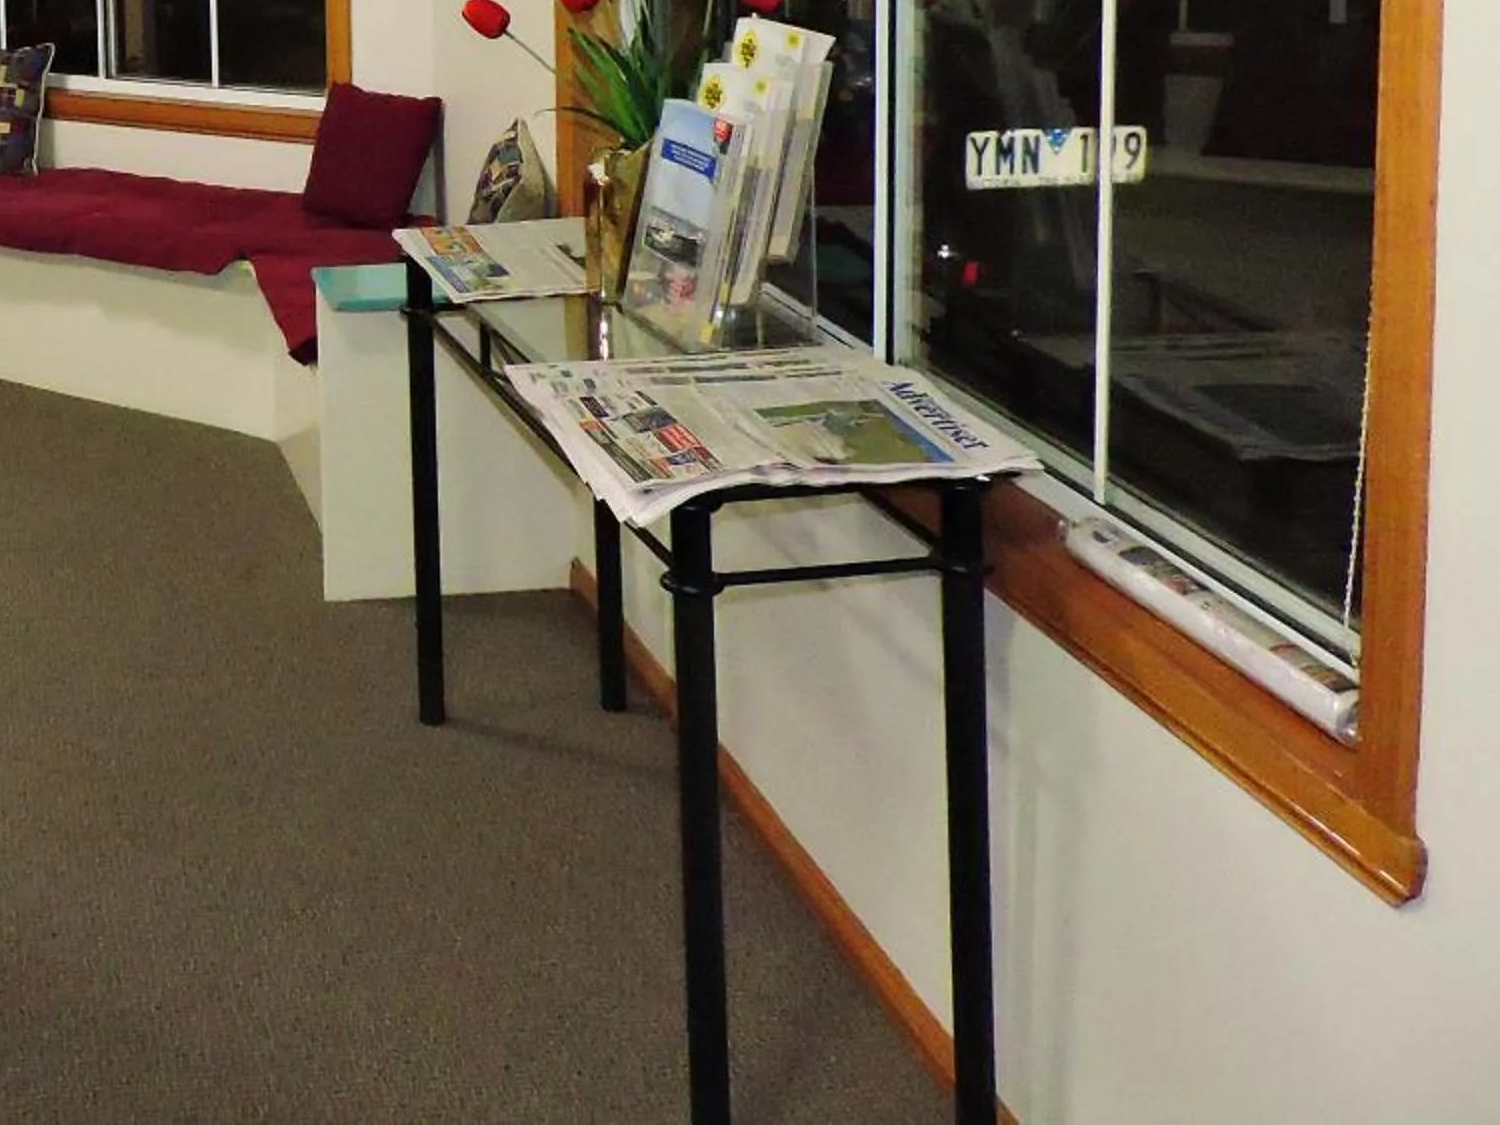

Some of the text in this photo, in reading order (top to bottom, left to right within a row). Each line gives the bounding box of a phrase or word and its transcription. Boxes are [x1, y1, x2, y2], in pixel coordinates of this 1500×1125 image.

[970, 131, 1142, 177] YMN 19
[884, 380, 989, 449] Advertiser
